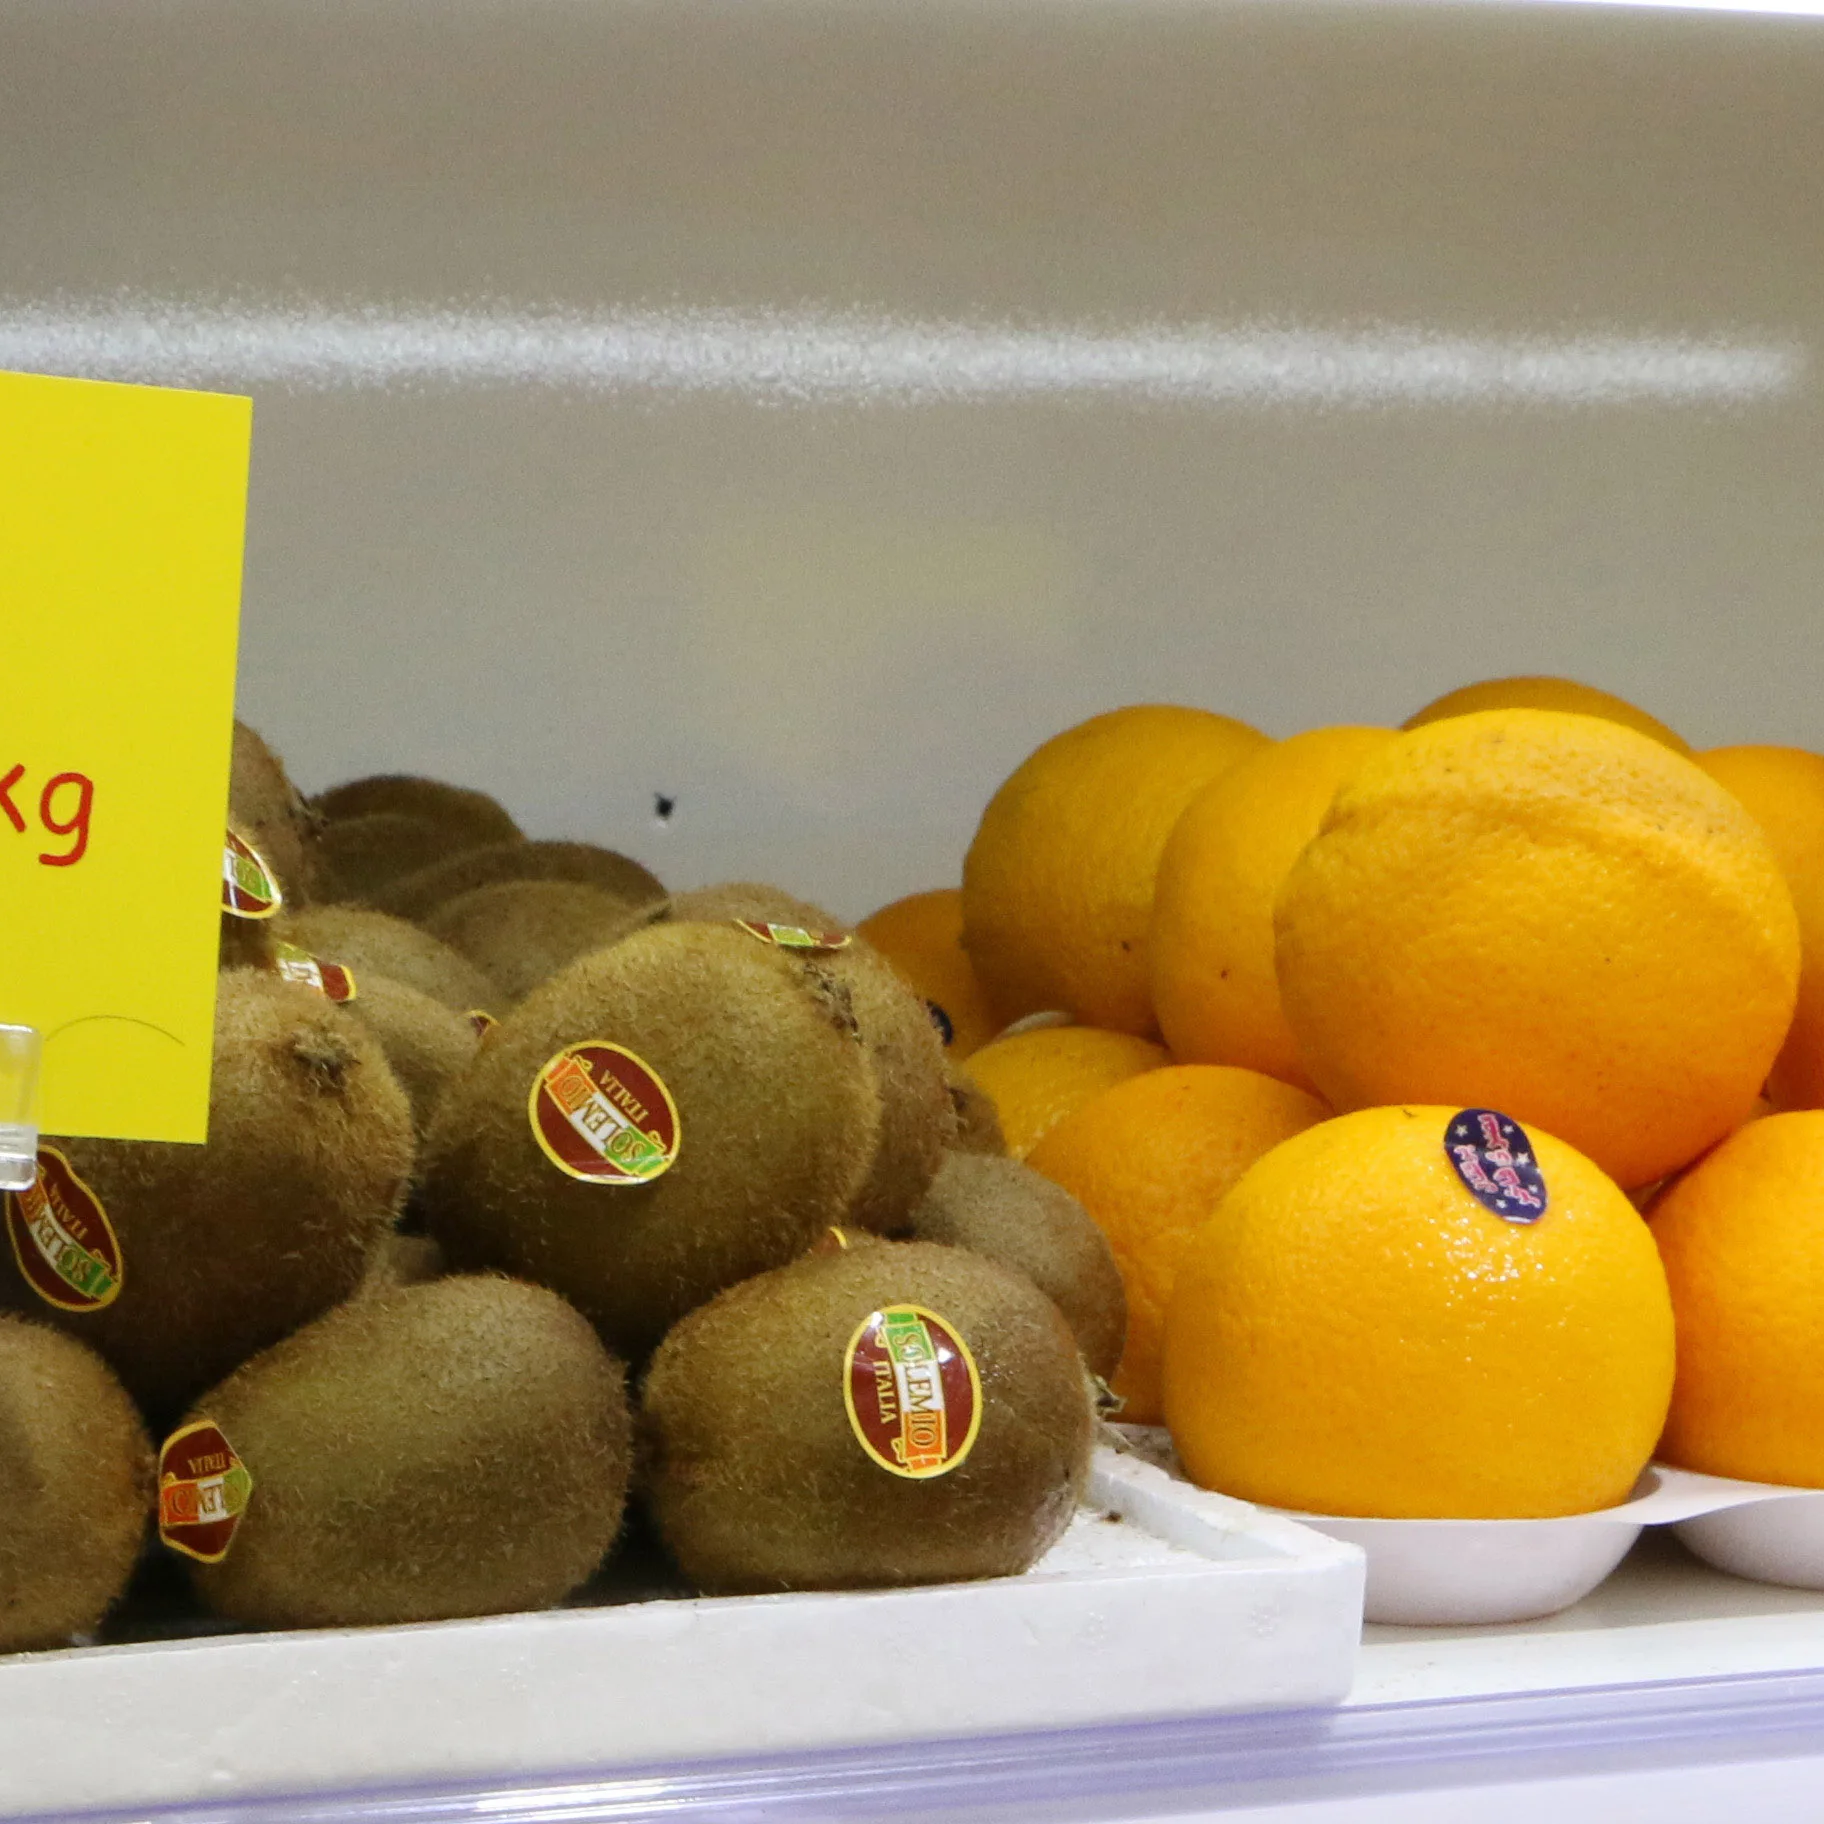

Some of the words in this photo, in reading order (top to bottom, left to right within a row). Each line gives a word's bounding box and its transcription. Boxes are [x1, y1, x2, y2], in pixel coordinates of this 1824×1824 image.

[599, 1068, 650, 1125] ITALIA
[873, 1360, 898, 1425] ITALIA
[187, 1452, 227, 1475] ITALIA
